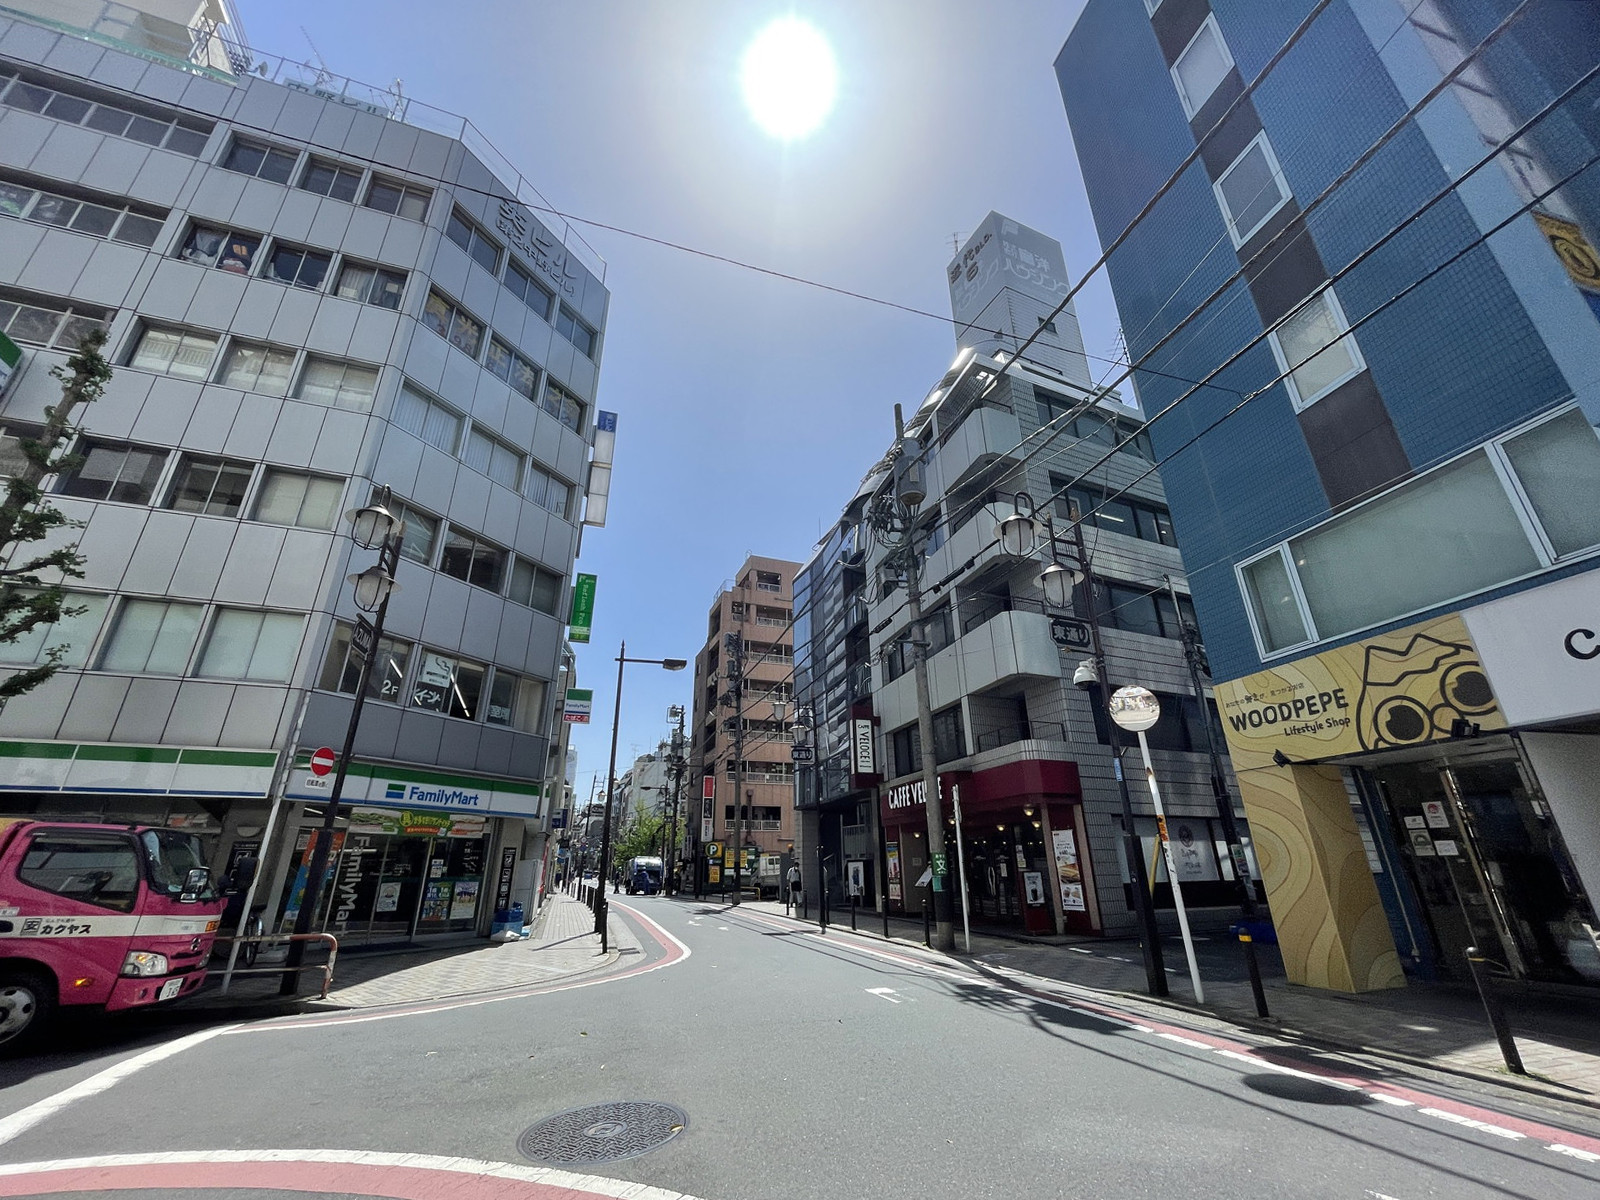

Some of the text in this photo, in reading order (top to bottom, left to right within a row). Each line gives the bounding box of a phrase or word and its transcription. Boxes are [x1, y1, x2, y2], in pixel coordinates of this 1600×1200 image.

[1052, 625, 1089, 643] 東通り
[381, 679, 399, 696] 2F
[1229, 688, 1349, 732] WOODPEPE
[1284, 716, 1351, 737] Lifestyle Shop
[860, 731, 871, 760] VELOCE
[408, 786, 479, 807] FamilyMart
[911, 776, 943, 804] VELE
[709, 845, 718, 855] P
[936, 859, 947, 871] 文
[335, 836, 371, 937] FamilyMart
[40, 924, 92, 935] カクヤス
